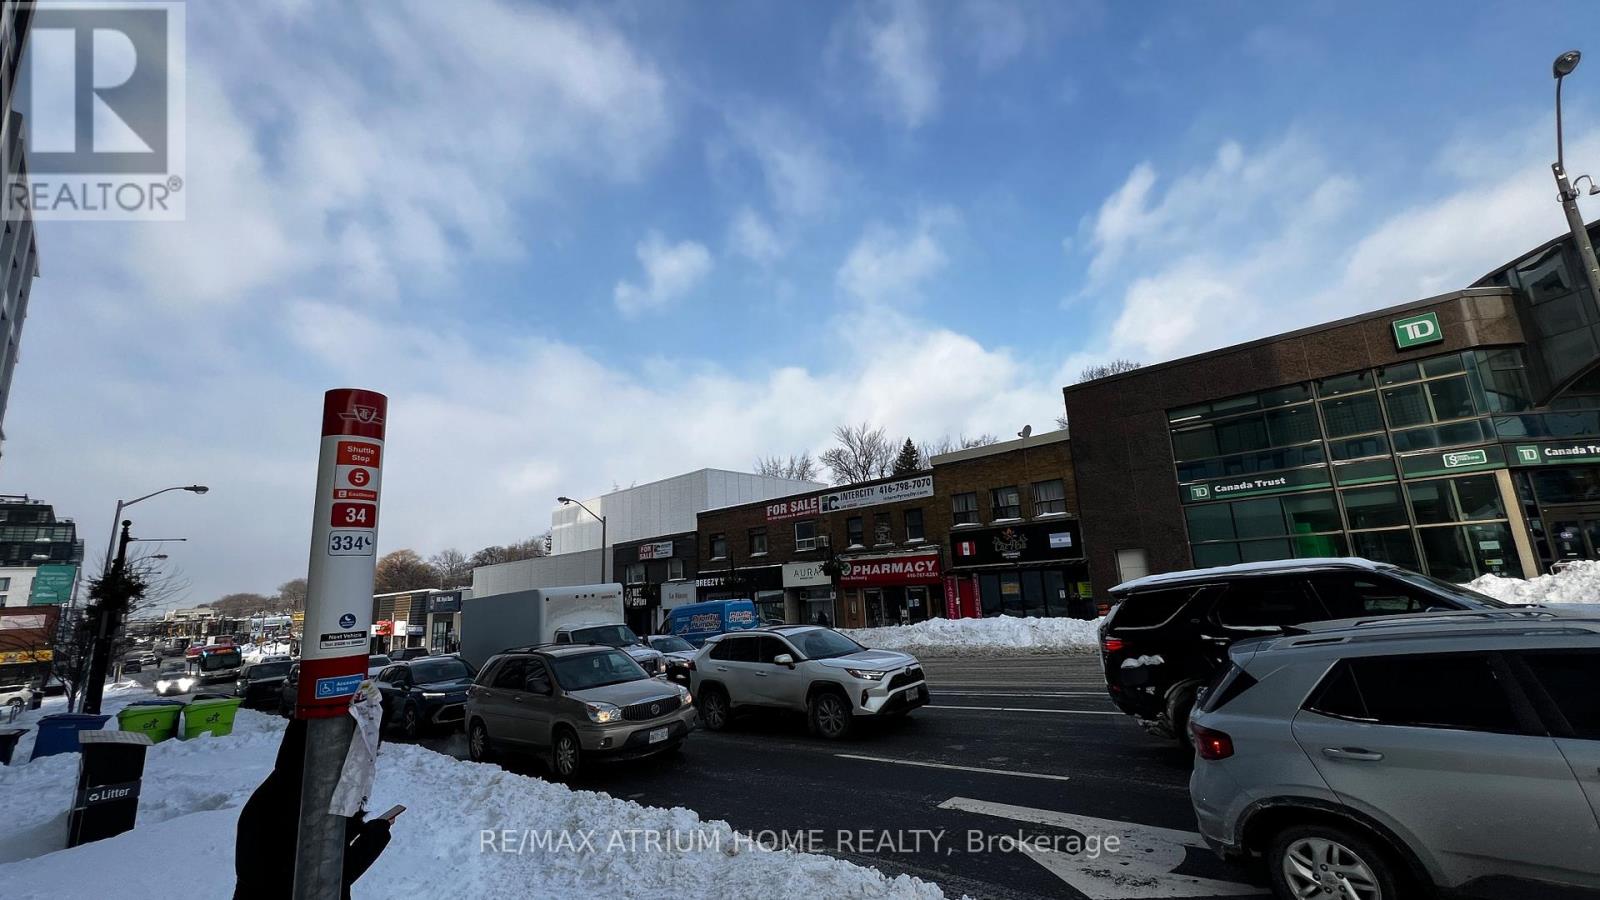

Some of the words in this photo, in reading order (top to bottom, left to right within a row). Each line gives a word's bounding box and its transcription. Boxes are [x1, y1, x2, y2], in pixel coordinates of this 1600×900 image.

[1398, 319, 1435, 340] TD
[347, 445, 375, 455] Shuttle
[1519, 449, 1538, 461] TD
[1544, 445, 1587, 456] Canada
[351, 454, 370, 463] Stop
[354, 472, 364, 483] 5
[840, 487, 875, 502] INTERCITY
[879, 477, 931, 495] 416-798-7070
[1192, 487, 1208, 497] TD
[1214, 481, 1253, 493] Canada
[1254, 477, 1286, 488] Trust
[345, 507, 366, 522] 34
[766, 502, 788, 517] FOR
[790, 498, 818, 514] SALE
[331, 535, 364, 551] 334
[640, 545, 652, 553] FOR
[639, 552, 652, 560] SALE
[793, 567, 819, 578] AURA
[852, 560, 936, 576] PHARMACY
[695, 578, 719, 587] BREEZY
[101, 787, 131, 801] Litter
